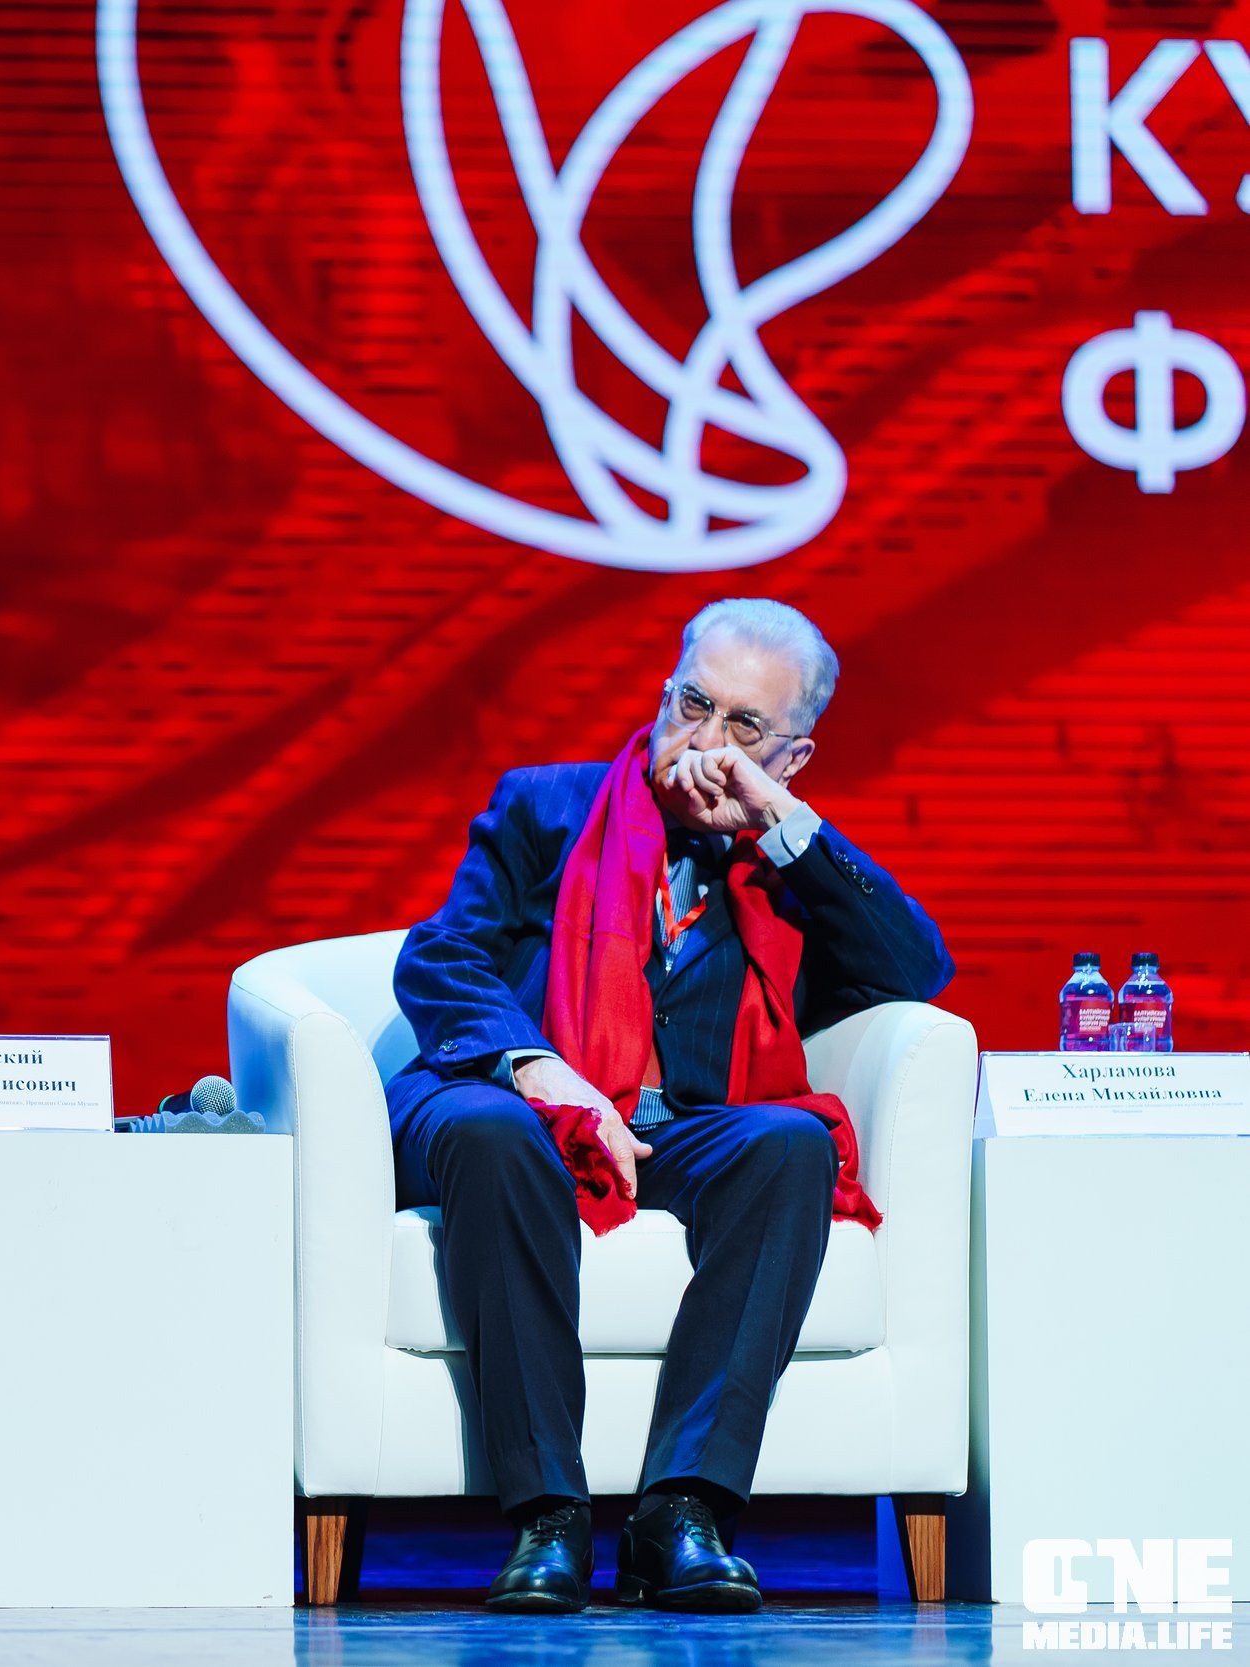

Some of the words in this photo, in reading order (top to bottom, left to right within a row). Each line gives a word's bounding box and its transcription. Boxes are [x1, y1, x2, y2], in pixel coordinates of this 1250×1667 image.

[1063, 1064, 1176, 1082] Харламова
[1023, 1087, 1085, 1102] Елена
[1092, 1085, 1222, 1101] Михайловна
